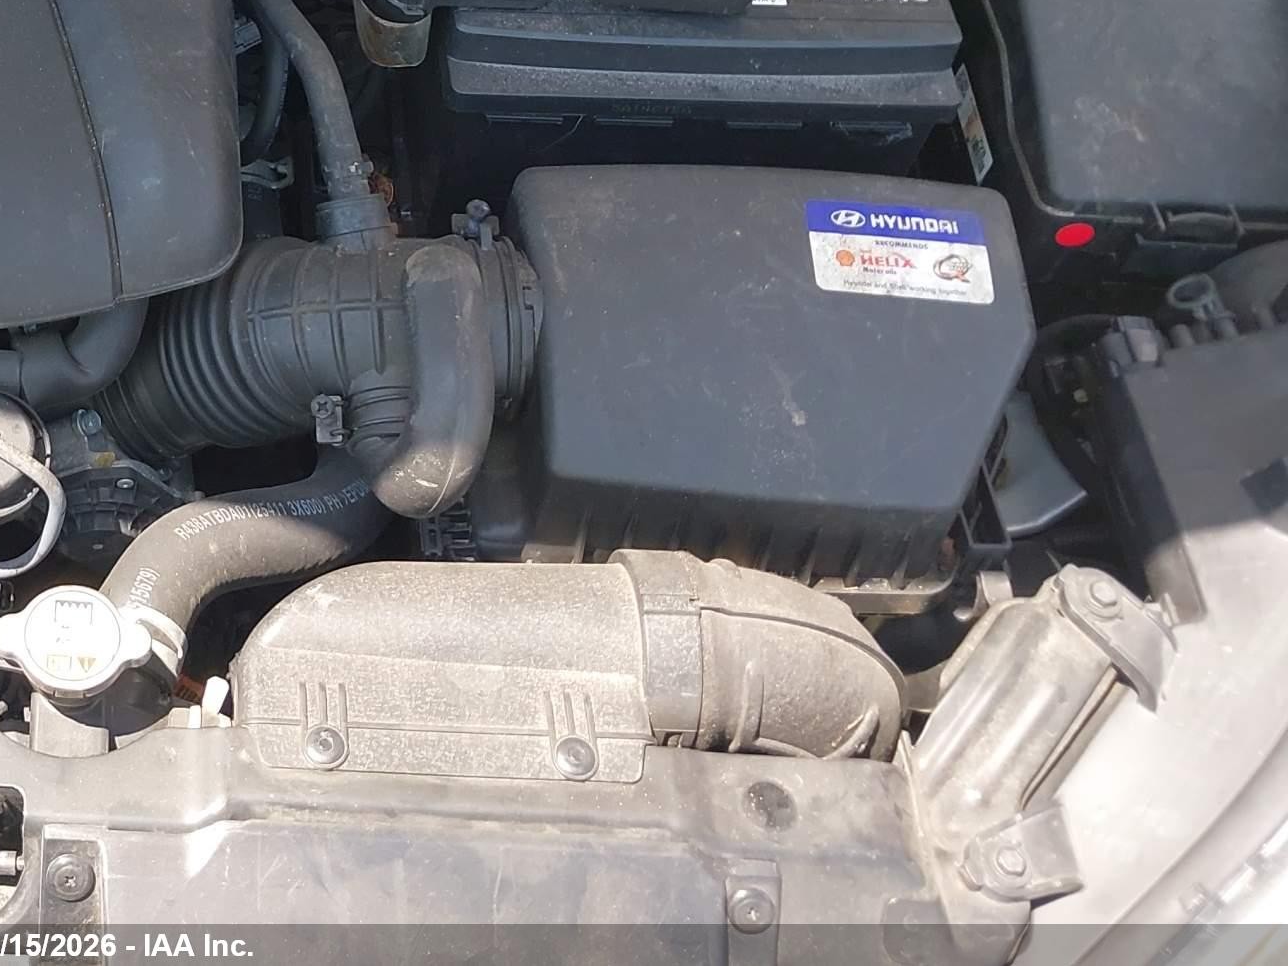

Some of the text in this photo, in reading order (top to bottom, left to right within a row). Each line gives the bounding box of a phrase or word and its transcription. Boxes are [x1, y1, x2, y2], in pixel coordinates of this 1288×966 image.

[869, 213, 960, 235] HYUNDAI
[874, 239, 930, 251] RECOMMENDS
[859, 252, 918, 270] HELIX
